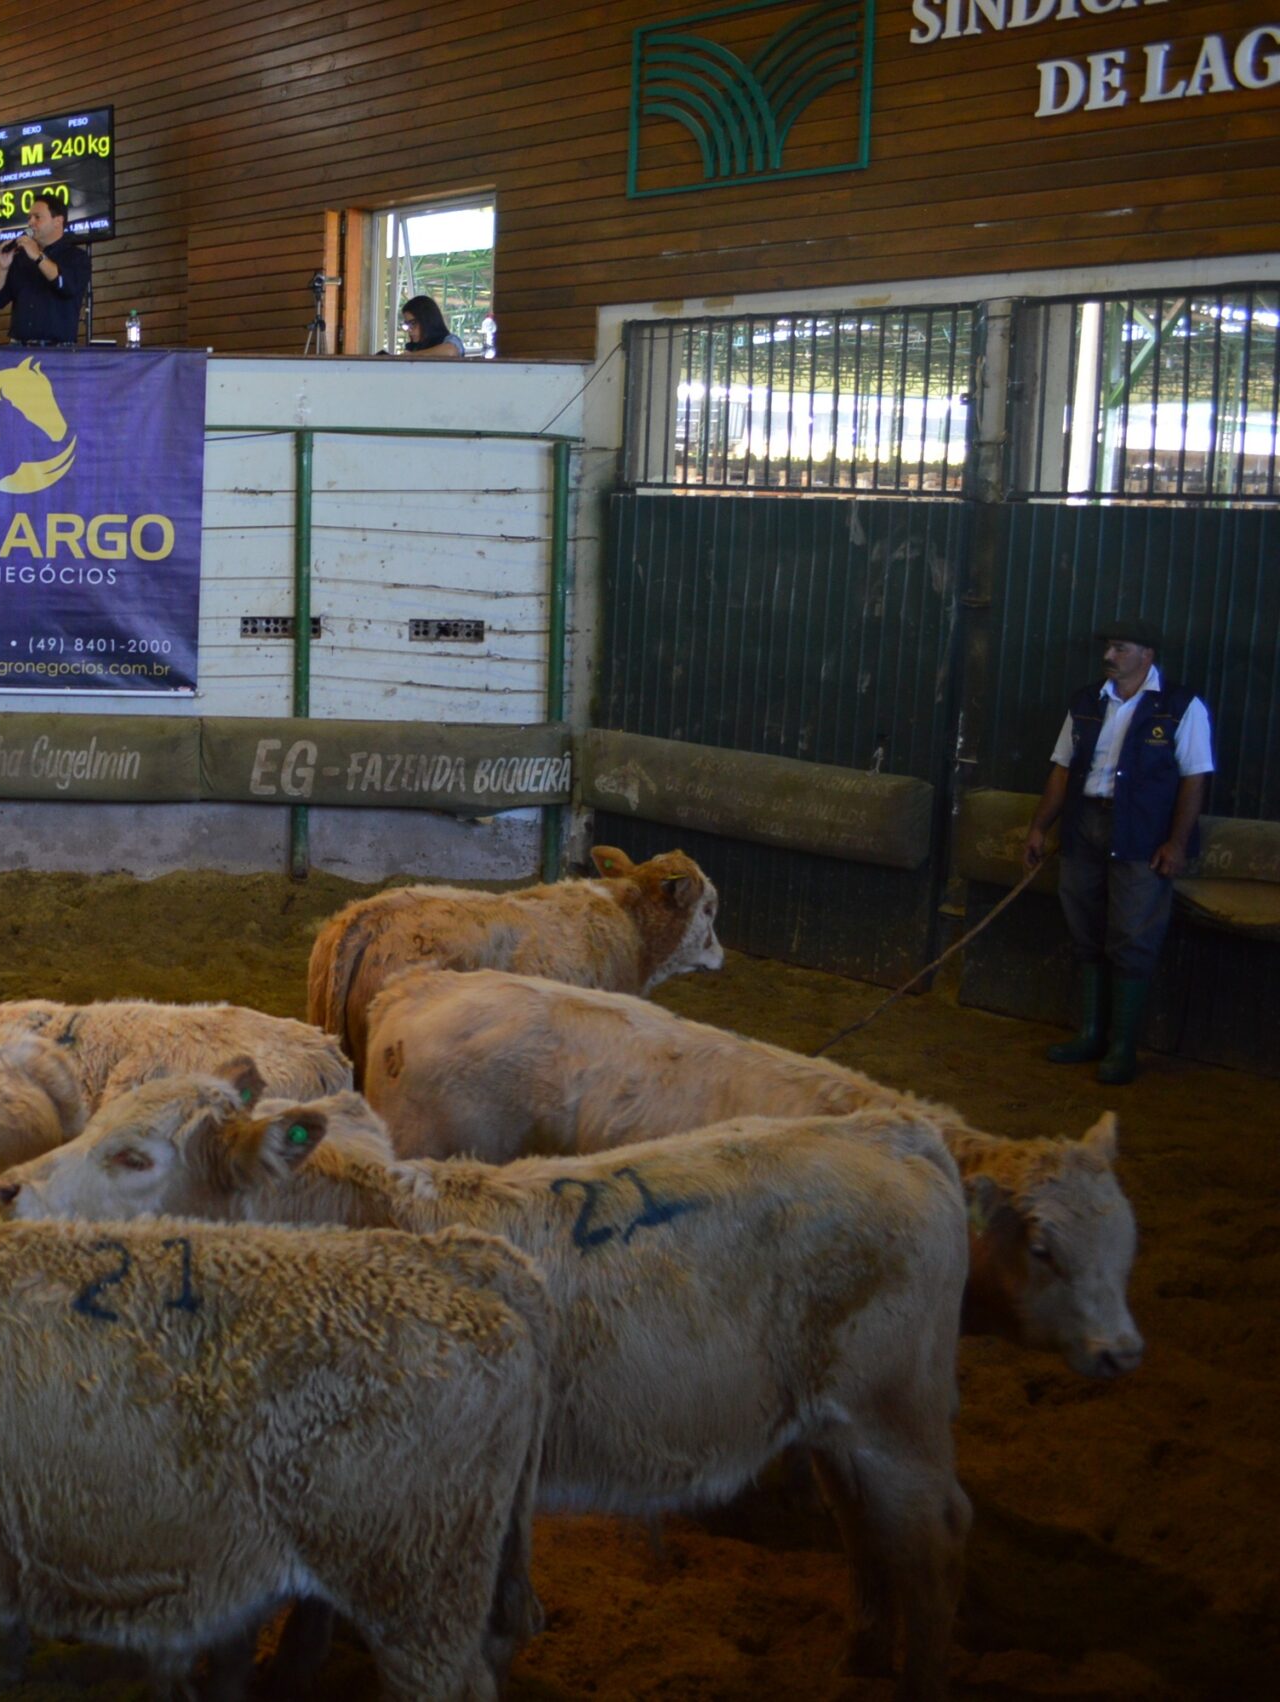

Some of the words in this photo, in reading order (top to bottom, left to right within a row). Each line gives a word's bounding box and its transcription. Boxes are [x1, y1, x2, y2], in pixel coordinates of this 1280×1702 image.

[1035, 50, 1127, 118] DE
[1140, 25, 1280, 103] LAG
[21, 143, 44, 166] M
[22, 126, 42, 136] SEXO
[68, 117, 89, 128] PESO
[28, 637, 64, 654] (49)
[74, 638, 172, 654] 8401-2000
[249, 738, 318, 798] EG
[346, 751, 466, 793] FAZENDA
[550, 1167, 702, 1256] 21
[72, 1237, 204, 1323] 21
